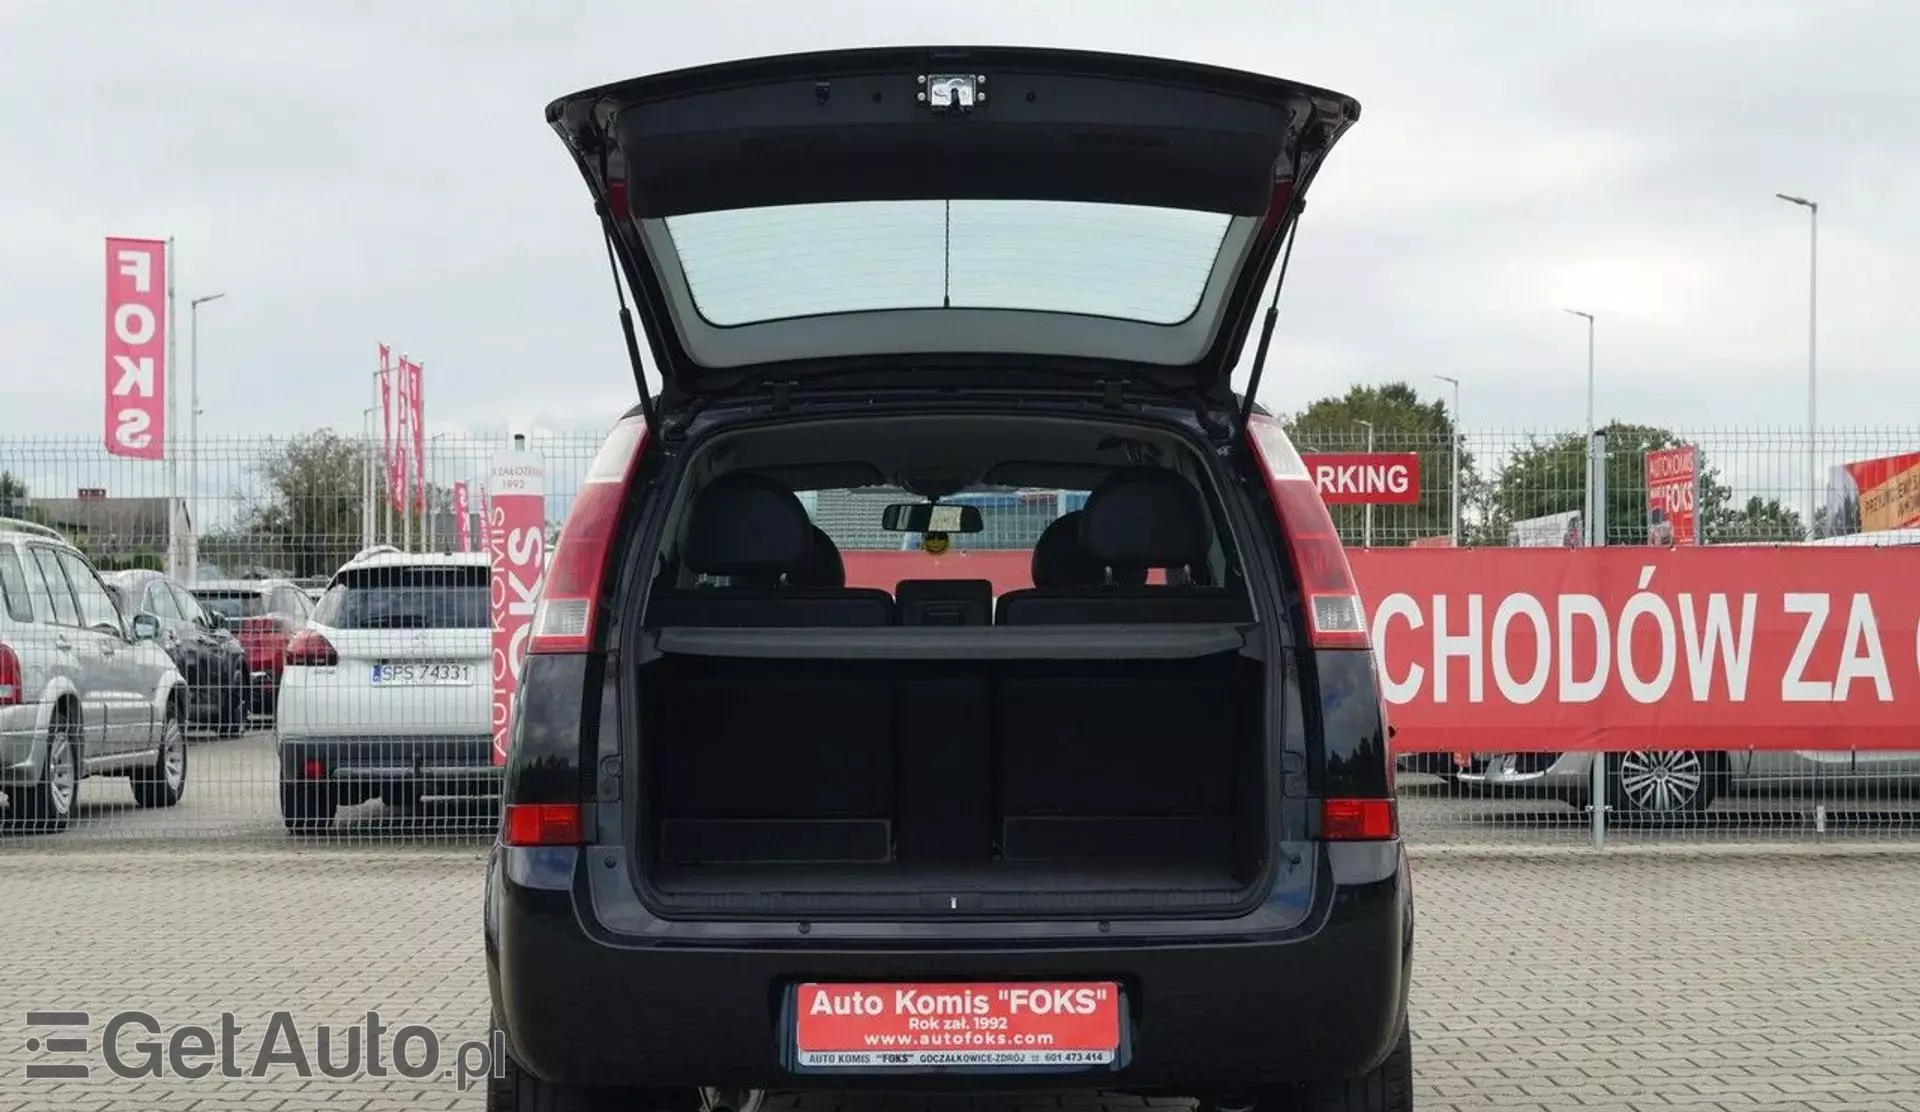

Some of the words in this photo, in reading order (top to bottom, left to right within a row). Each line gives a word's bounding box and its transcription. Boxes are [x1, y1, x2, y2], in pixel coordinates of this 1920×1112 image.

[1665, 481, 1694, 513] FOKS
[490, 506, 506, 633] KOMIS
[1372, 565, 1758, 705] CHODÓW
[1781, 592, 1894, 702] ZA
[382, 665, 414, 681] SPS
[419, 665, 469, 681] 74331
[493, 647, 507, 757] AUTO
[810, 990, 883, 1016] Auto
[896, 990, 989, 1016] Komis
[998, 989, 1107, 1015] "FOKS"
[908, 1017, 939, 1030] Rok
[943, 1017, 970, 1030] zał.
[974, 1017, 1008, 1030] 1992
[864, 1031, 1054, 1046] www.autofoks.com
[809, 1054, 835, 1064] AUTO
[838, 1054, 870, 1064] KOMIS
[876, 1053, 914, 1064] "FOKS"
[1065, 1053, 1082, 1063] 473
[1085, 1053, 1103, 1063] 414
